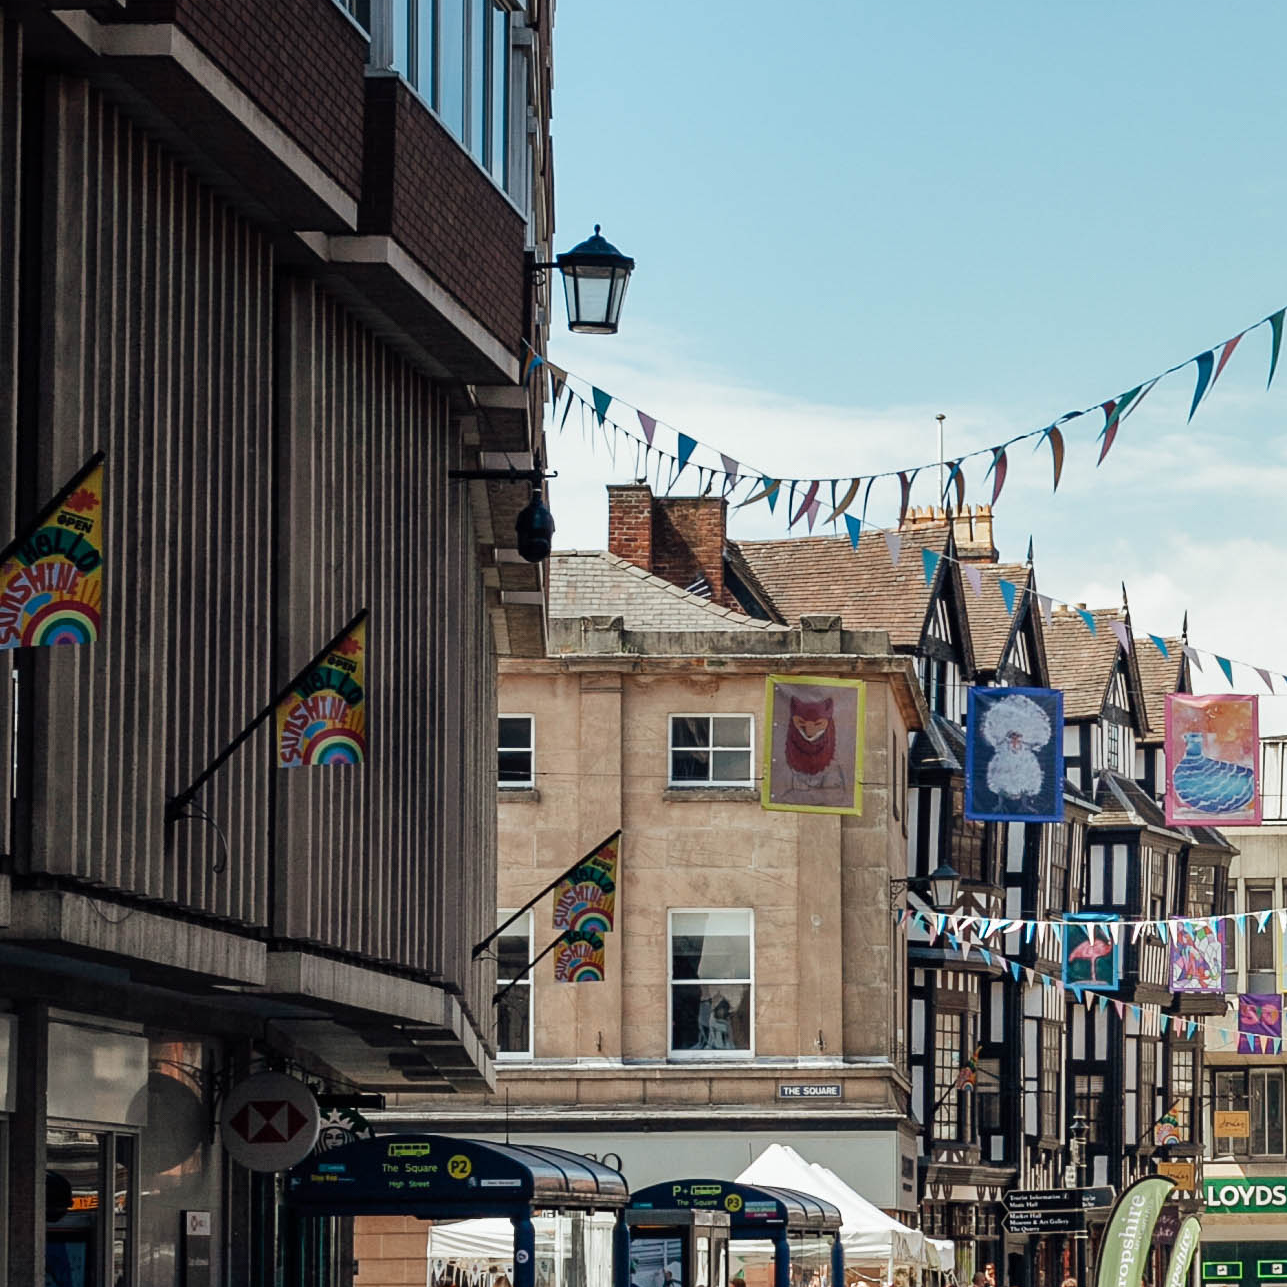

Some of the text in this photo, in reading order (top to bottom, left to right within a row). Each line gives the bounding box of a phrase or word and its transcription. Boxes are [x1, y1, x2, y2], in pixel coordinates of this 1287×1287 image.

[57, 515, 94, 534] OPEN
[783, 1086, 838, 1096] THE SQUARE
[382, 1163, 438, 1174] The Square
[450, 1160, 468, 1175] P2
[388, 1179, 430, 1189] High Street
[672, 1185, 681, 1197] P
[1203, 1185, 1287, 1206] LOYDS
[693, 1199, 718, 1207] Square
[727, 1196, 740, 1209] P3
